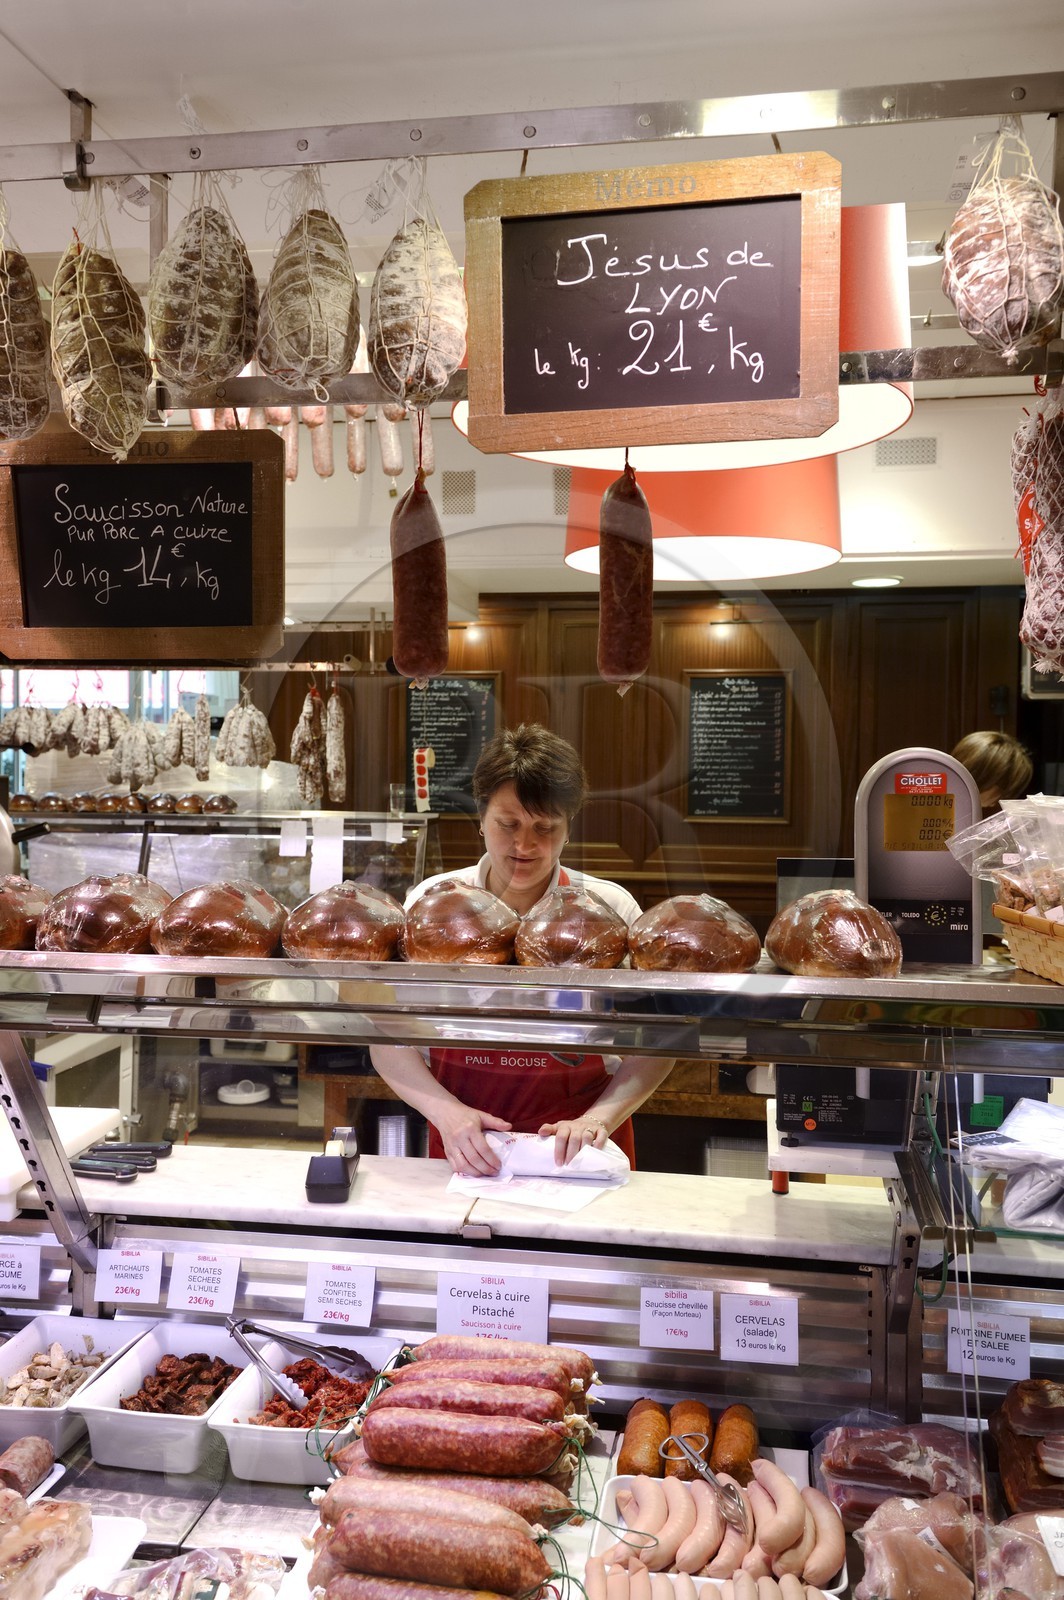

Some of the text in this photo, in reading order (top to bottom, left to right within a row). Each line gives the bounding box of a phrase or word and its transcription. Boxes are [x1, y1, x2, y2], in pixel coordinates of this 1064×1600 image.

[596, 173, 697, 201] Mémo
[556, 233, 775, 286] Jésus de
[624, 275, 738, 316] LYON
[534, 348, 556, 376] le
[54, 483, 248, 524] Saucisson Nature
[67, 525, 96, 543] PUR
[103, 523, 140, 540] PORC
[173, 524, 233, 543] cuire
[900, 776, 943, 786] CHOLLET
[943, 795, 954, 809] kg
[950, 922, 969, 931] mira
[465, 1055, 548, 1068] PAUL BOCUSE
[109, 1264, 150, 1273] ARTICHAUTS
[189, 1266, 223, 1276] TOMATES
[331, 1264, 352, 1272] SIBILIA
[114, 1272, 144, 1280] MARINES
[187, 1275, 221, 1285] SECHEES
[480, 1276, 506, 1286] SIBILIA
[324, 1280, 356, 1290] TOMATES
[114, 1286, 141, 1297] 23€/kg
[322, 1289, 357, 1298] CONFITES
[449, 1287, 531, 1302] Cervelas à cuire
[664, 1290, 688, 1300] sibilia
[188, 1296, 215, 1307] 23€/kg
[317, 1296, 363, 1307] SEMI SECHES
[645, 1300, 708, 1310] Saucisse chevillée
[749, 1299, 771, 1307] SIBILIA
[323, 1310, 350, 1322] 23€/kg
[472, 1306, 515, 1318] Pistaché
[651, 1310, 702, 1319] (Façon Morteau)
[460, 1319, 522, 1332] Saucisson à cuire
[735, 1314, 786, 1327] CERVELAS
[976, 1321, 1000, 1330] SIBILIA
[665, 1328, 688, 1338] 17€/kg
[743, 1327, 778, 1339] (salade)
[950, 1326, 1027, 1343] POITRINE FUMEE
[735, 1338, 786, 1353] 13 euros le Kg
[967, 1339, 1010, 1351] ET SALEE
[962, 1350, 1016, 1366] 12 euros le Kg
